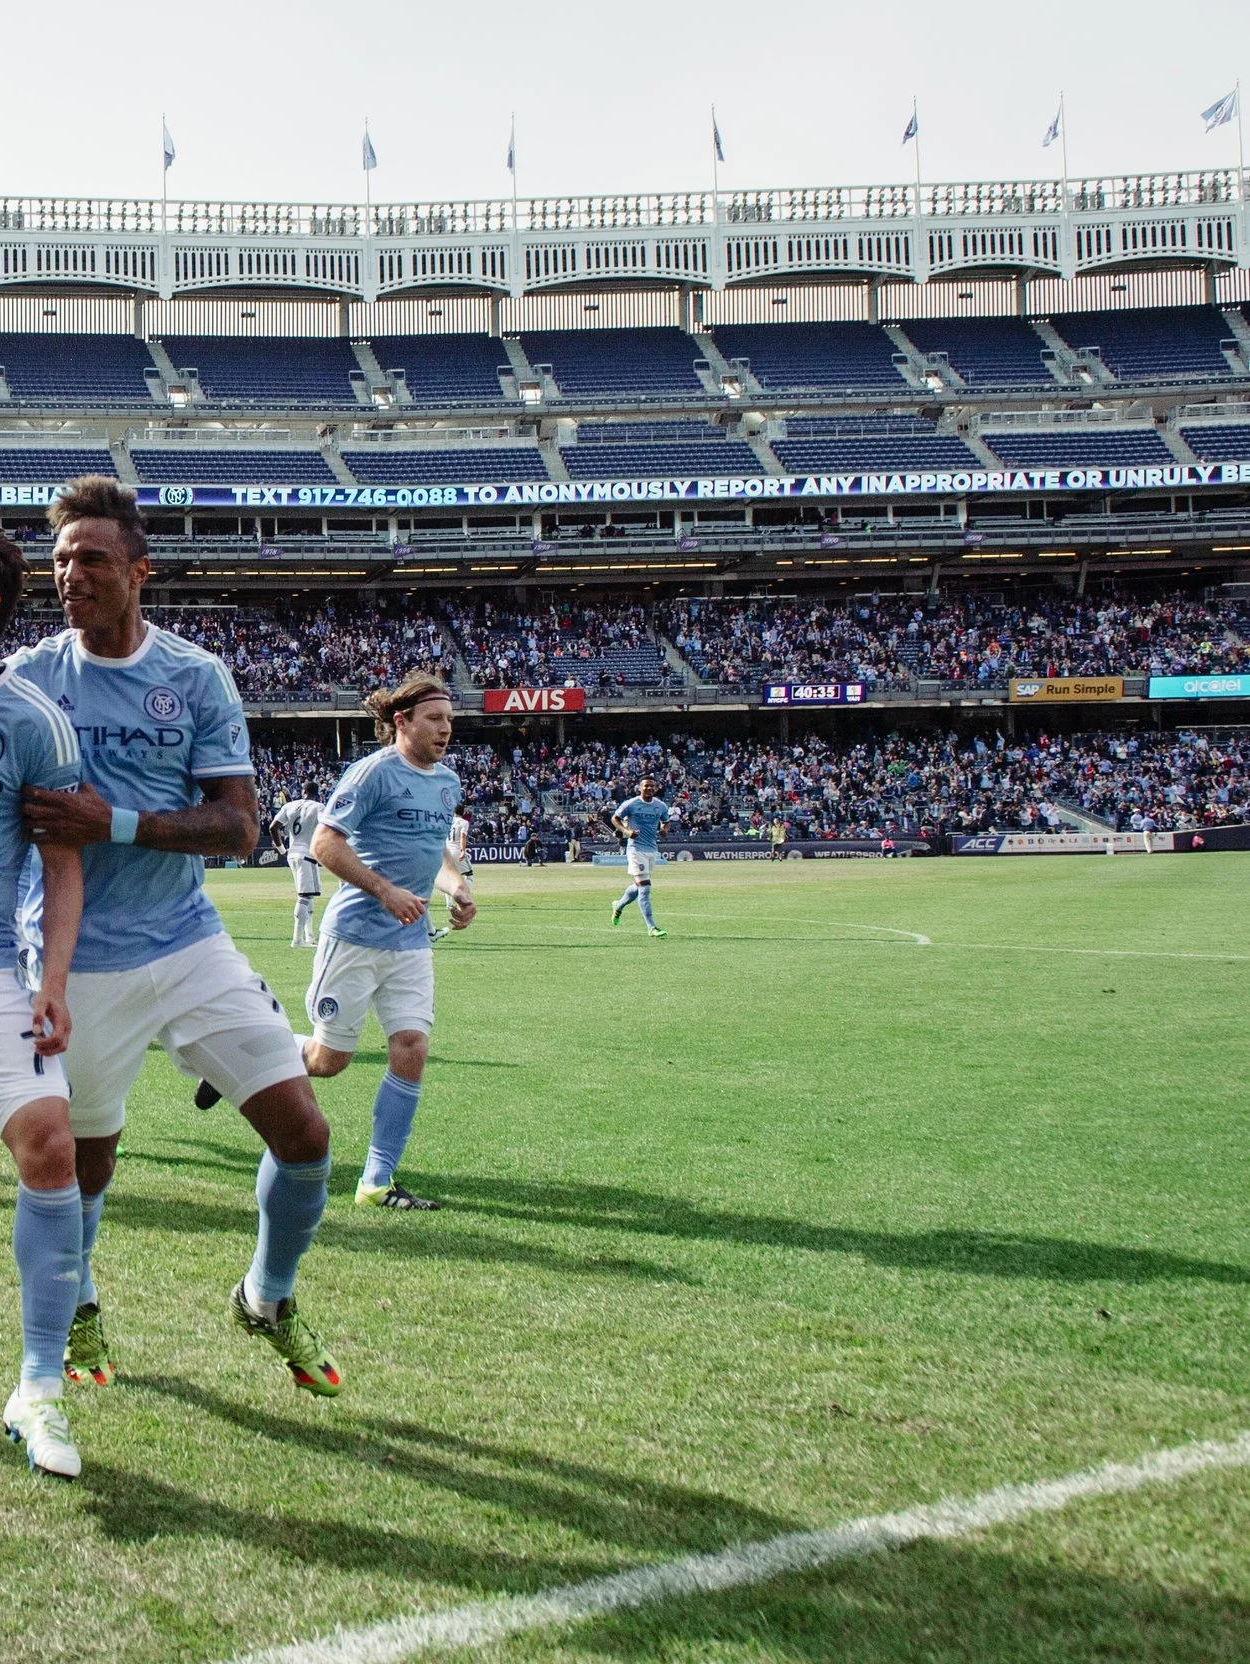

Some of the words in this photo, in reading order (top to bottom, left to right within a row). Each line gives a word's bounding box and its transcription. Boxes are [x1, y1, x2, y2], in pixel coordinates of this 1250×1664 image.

[232, 488, 292, 506] TEXT
[298, 487, 458, 507] 917-746-0088
[464, 486, 498, 504] TO
[503, 481, 692, 502] ANONYMOUSLY
[698, 478, 795, 498] REPORT
[801, 475, 857, 495] ANY
[861, 471, 1060, 494] INAPPROPRIATE
[1066, 471, 1103, 489] OR
[1109, 465, 1214, 487] UNRULY
[1221, 464, 1250, 483] BE
[1, 486, 64, 505] BEHA
[794, 686, 836, 699] 40:35
[1016, 684, 1040, 697] SAP
[1046, 684, 1070, 695] Run
[1073, 683, 1116, 698] Simple
[1184, 678, 1241, 694] alcatel
[504, 689, 566, 712] AVIS
[74, 726, 184, 748] TIHAD
[81, 749, 164, 760] IRWAYS
[292, 816, 301, 836] 6
[962, 837, 998, 850] ACC
[465, 847, 525, 861] STADIUM
